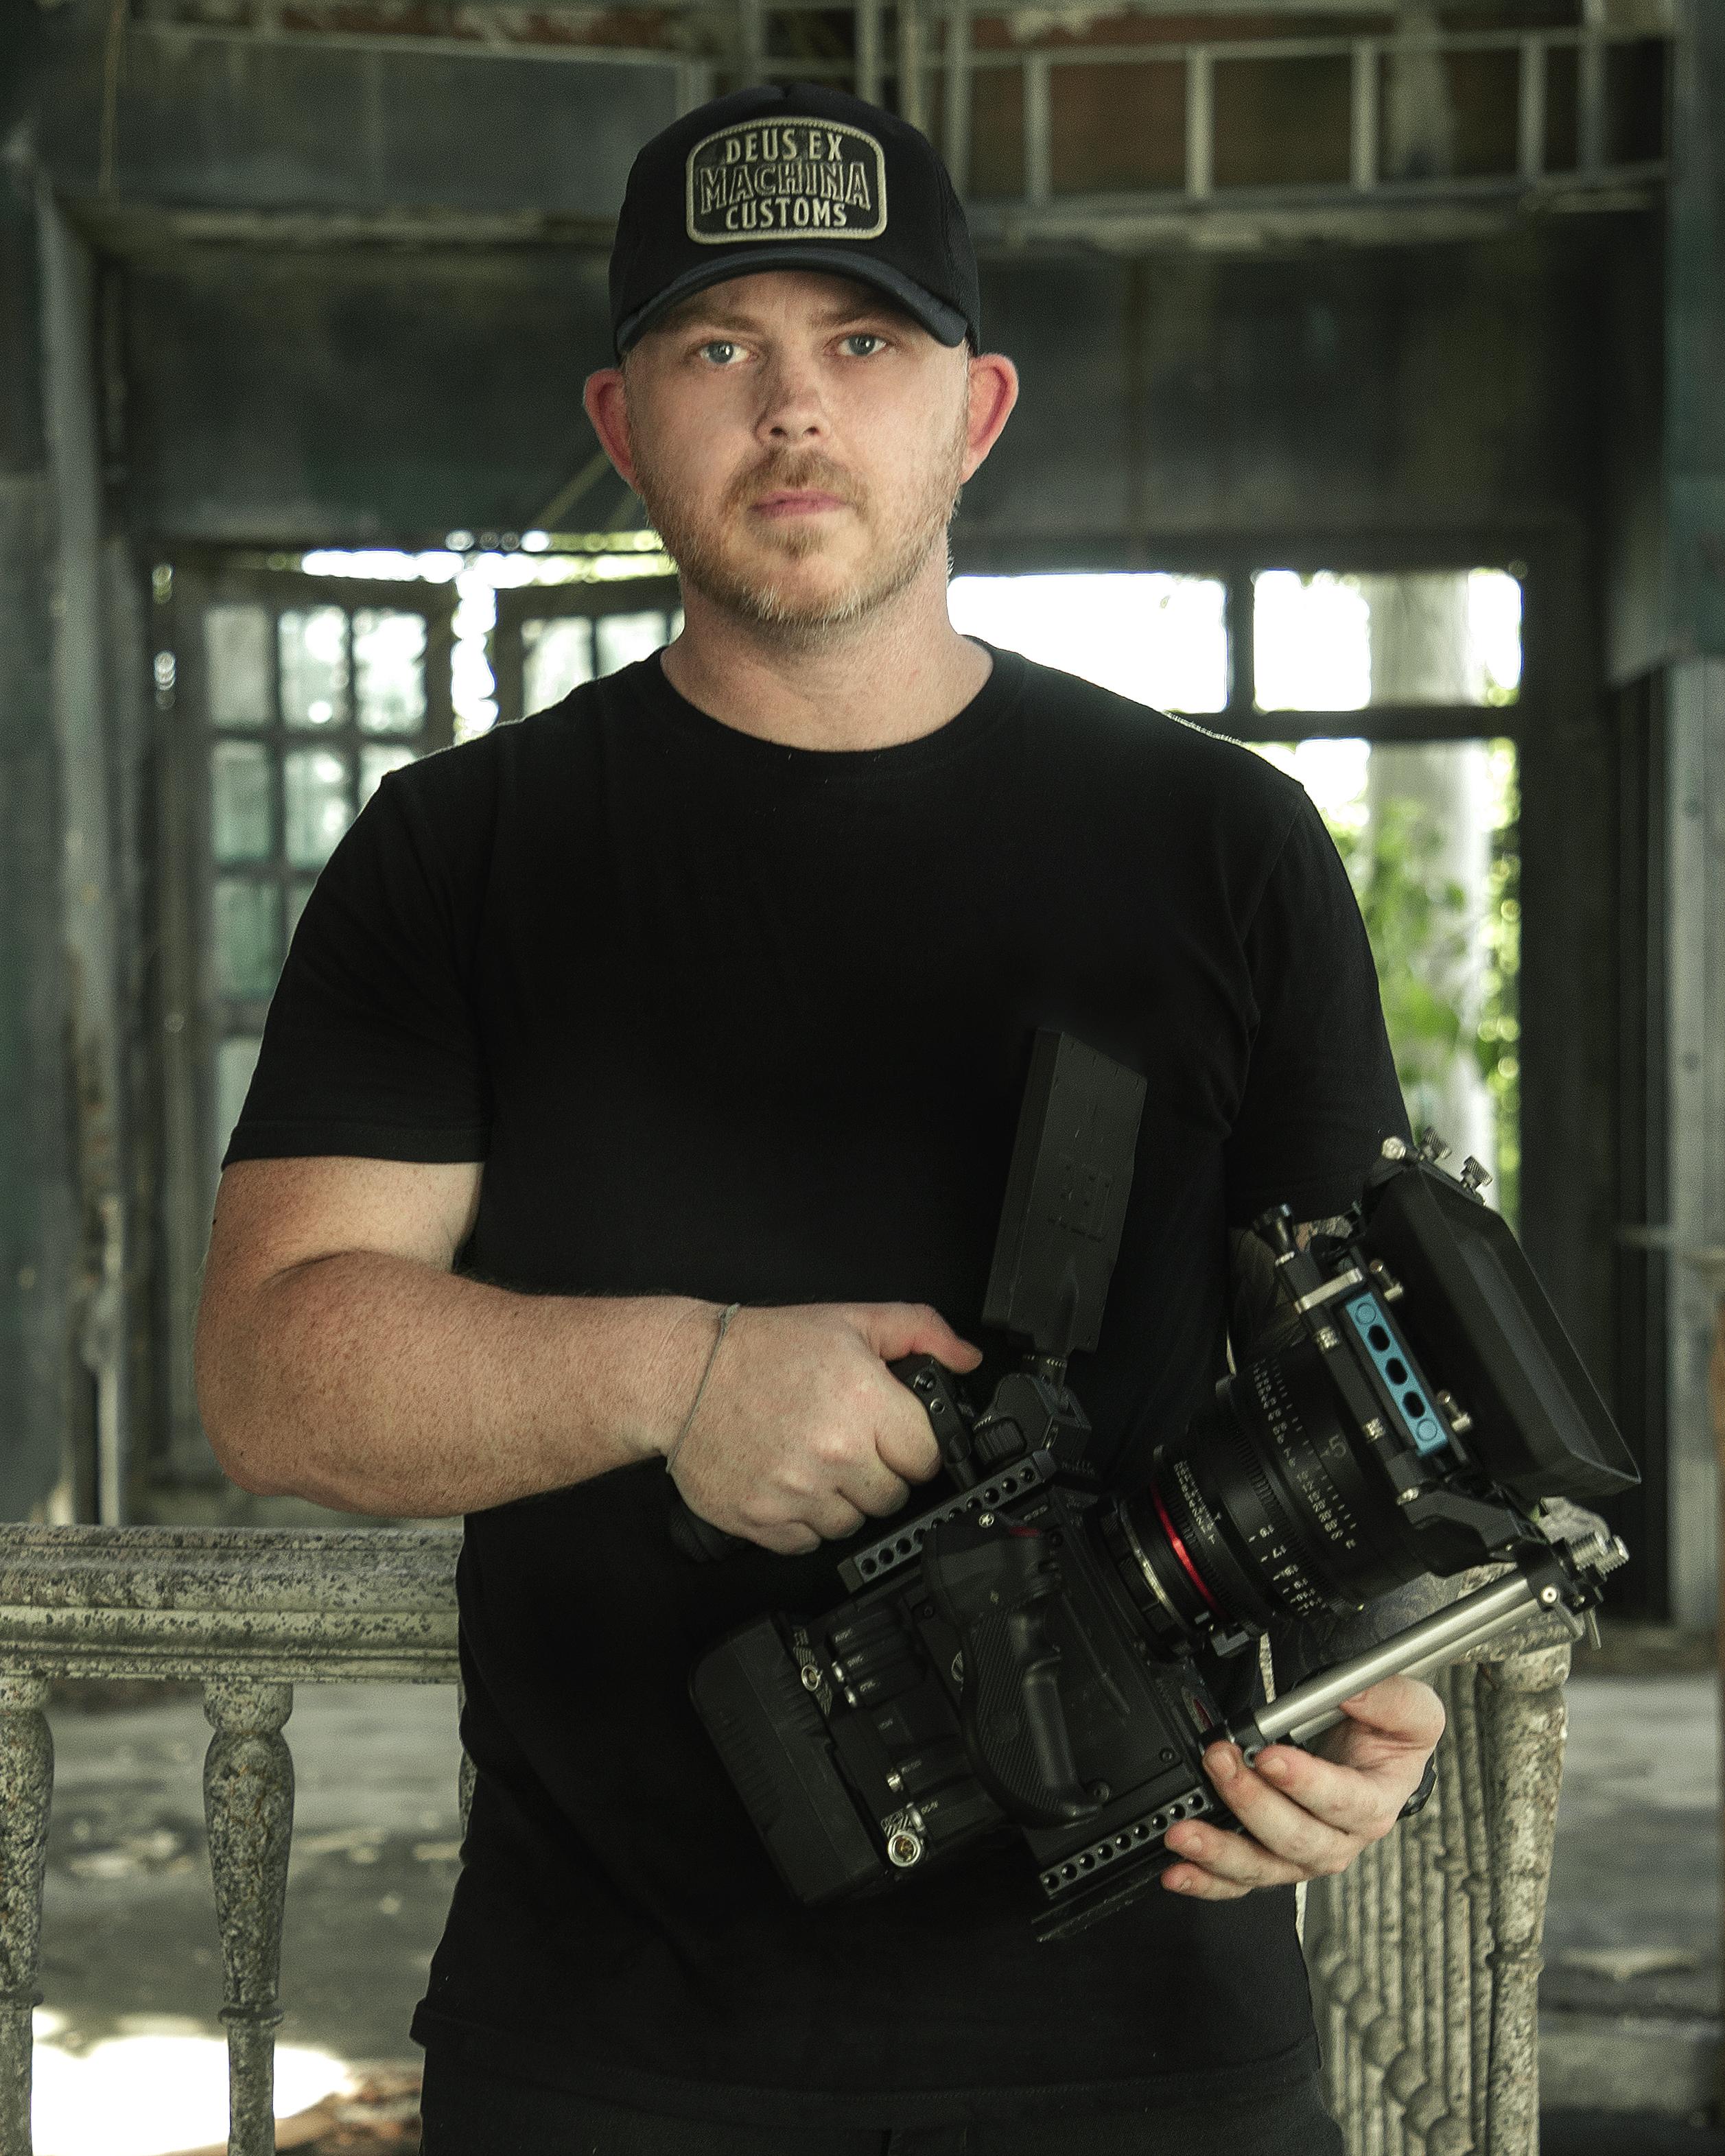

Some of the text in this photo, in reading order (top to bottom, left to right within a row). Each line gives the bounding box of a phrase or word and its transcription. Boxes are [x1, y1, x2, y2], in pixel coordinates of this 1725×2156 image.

[725, 128, 843, 165] DEUS EX
[700, 159, 871, 215] MACHINA
[725, 197, 847, 231] CUSTOMS
